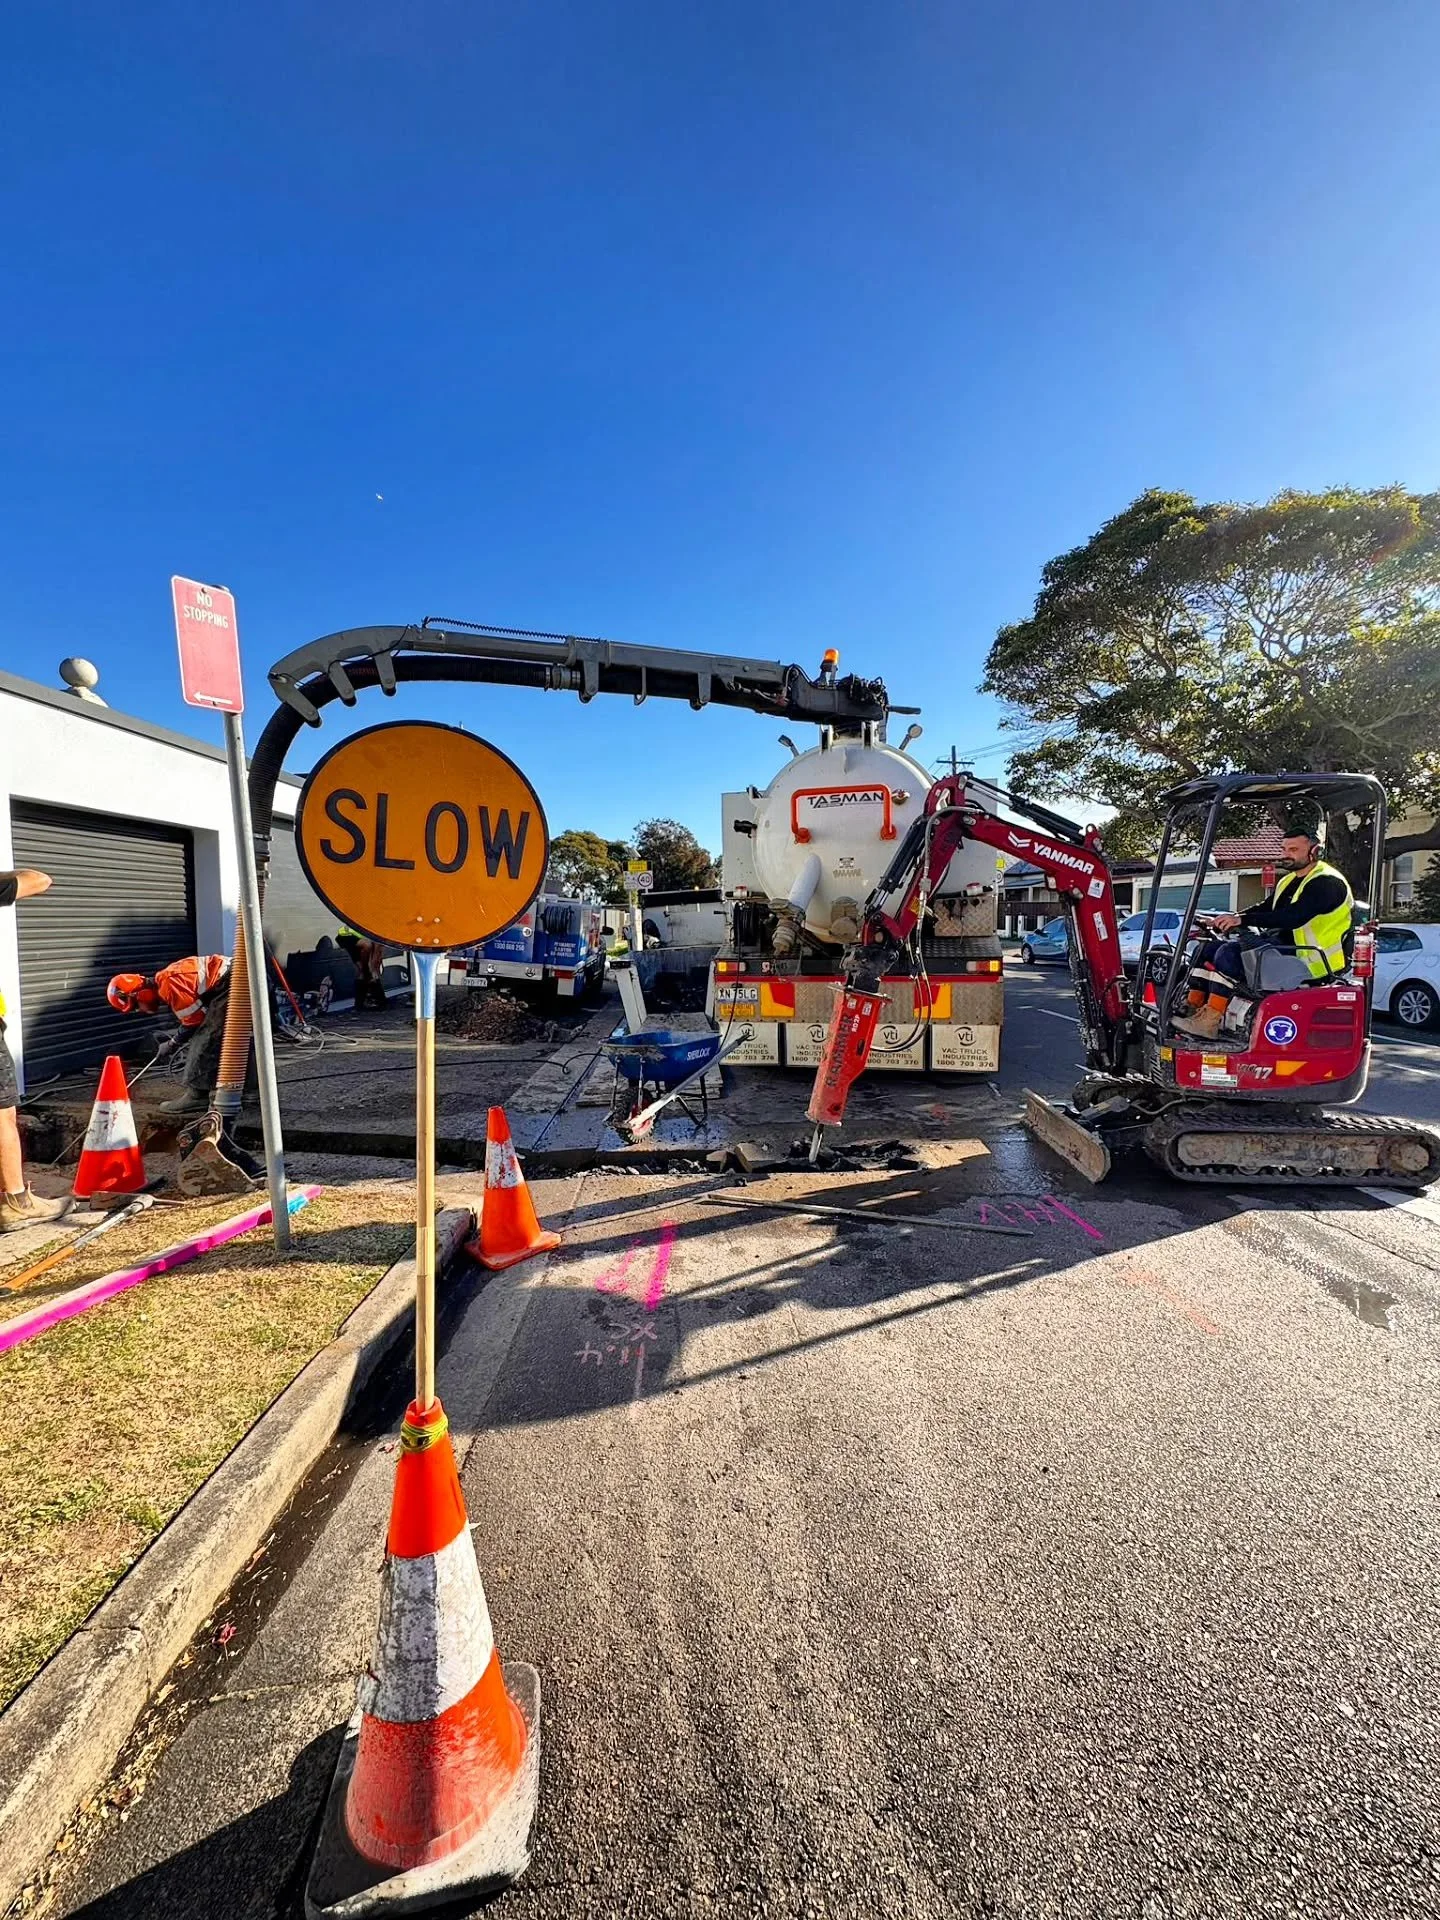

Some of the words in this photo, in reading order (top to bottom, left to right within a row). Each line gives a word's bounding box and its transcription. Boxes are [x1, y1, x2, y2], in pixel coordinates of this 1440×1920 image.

[196, 591, 213, 608] NO
[183, 605, 229, 629] STOPPING
[807, 792, 884, 809] TASMAN
[319, 788, 531, 880] SLOW
[1032, 841, 1095, 875] YANMAR
[810, 1027, 825, 1039] vti
[883, 1030, 898, 1041] vti
[957, 1031, 974, 1041] vti
[961, 1047, 988, 1055] TRUCK
